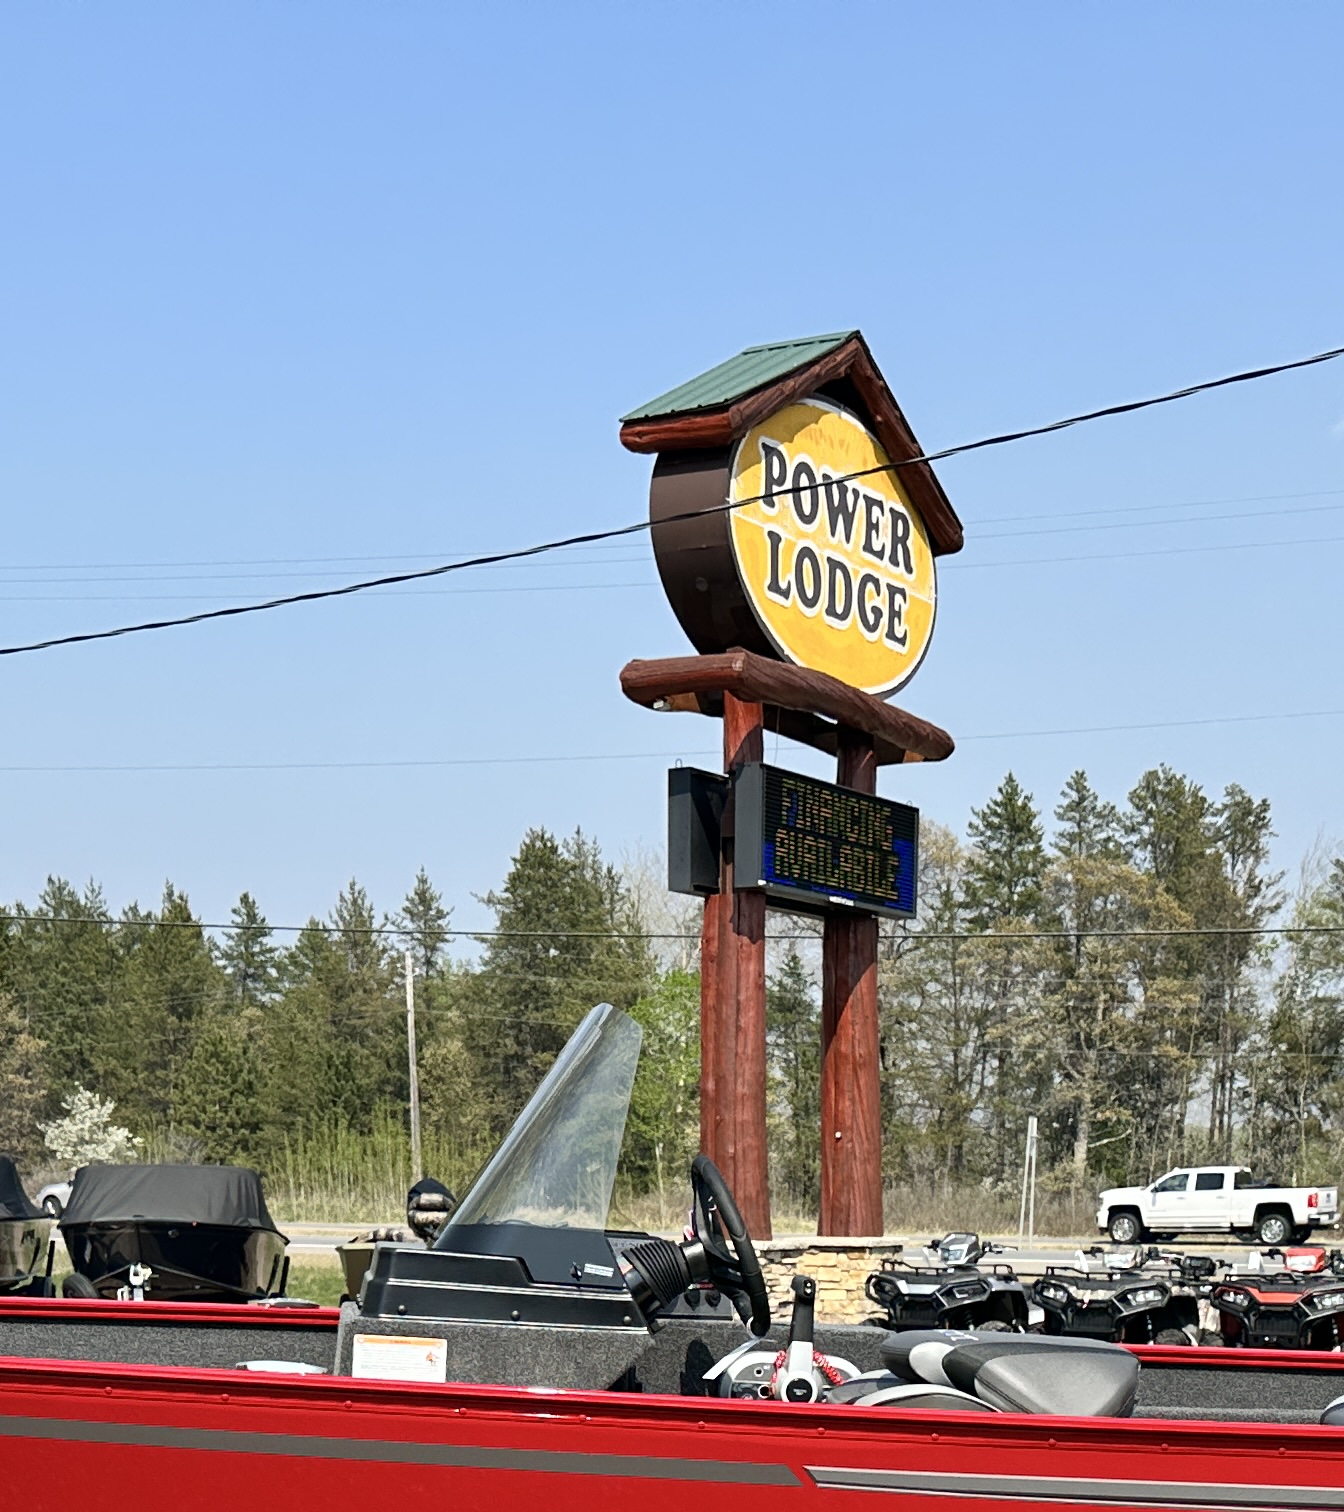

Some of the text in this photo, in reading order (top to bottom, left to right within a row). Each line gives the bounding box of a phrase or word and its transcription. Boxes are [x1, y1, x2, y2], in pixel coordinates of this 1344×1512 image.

[760, 440, 914, 576] POWER
[766, 529, 909, 649] LODGE
[779, 777, 894, 851] FINANCING
[773, 827, 900, 901] AVAILABLE
